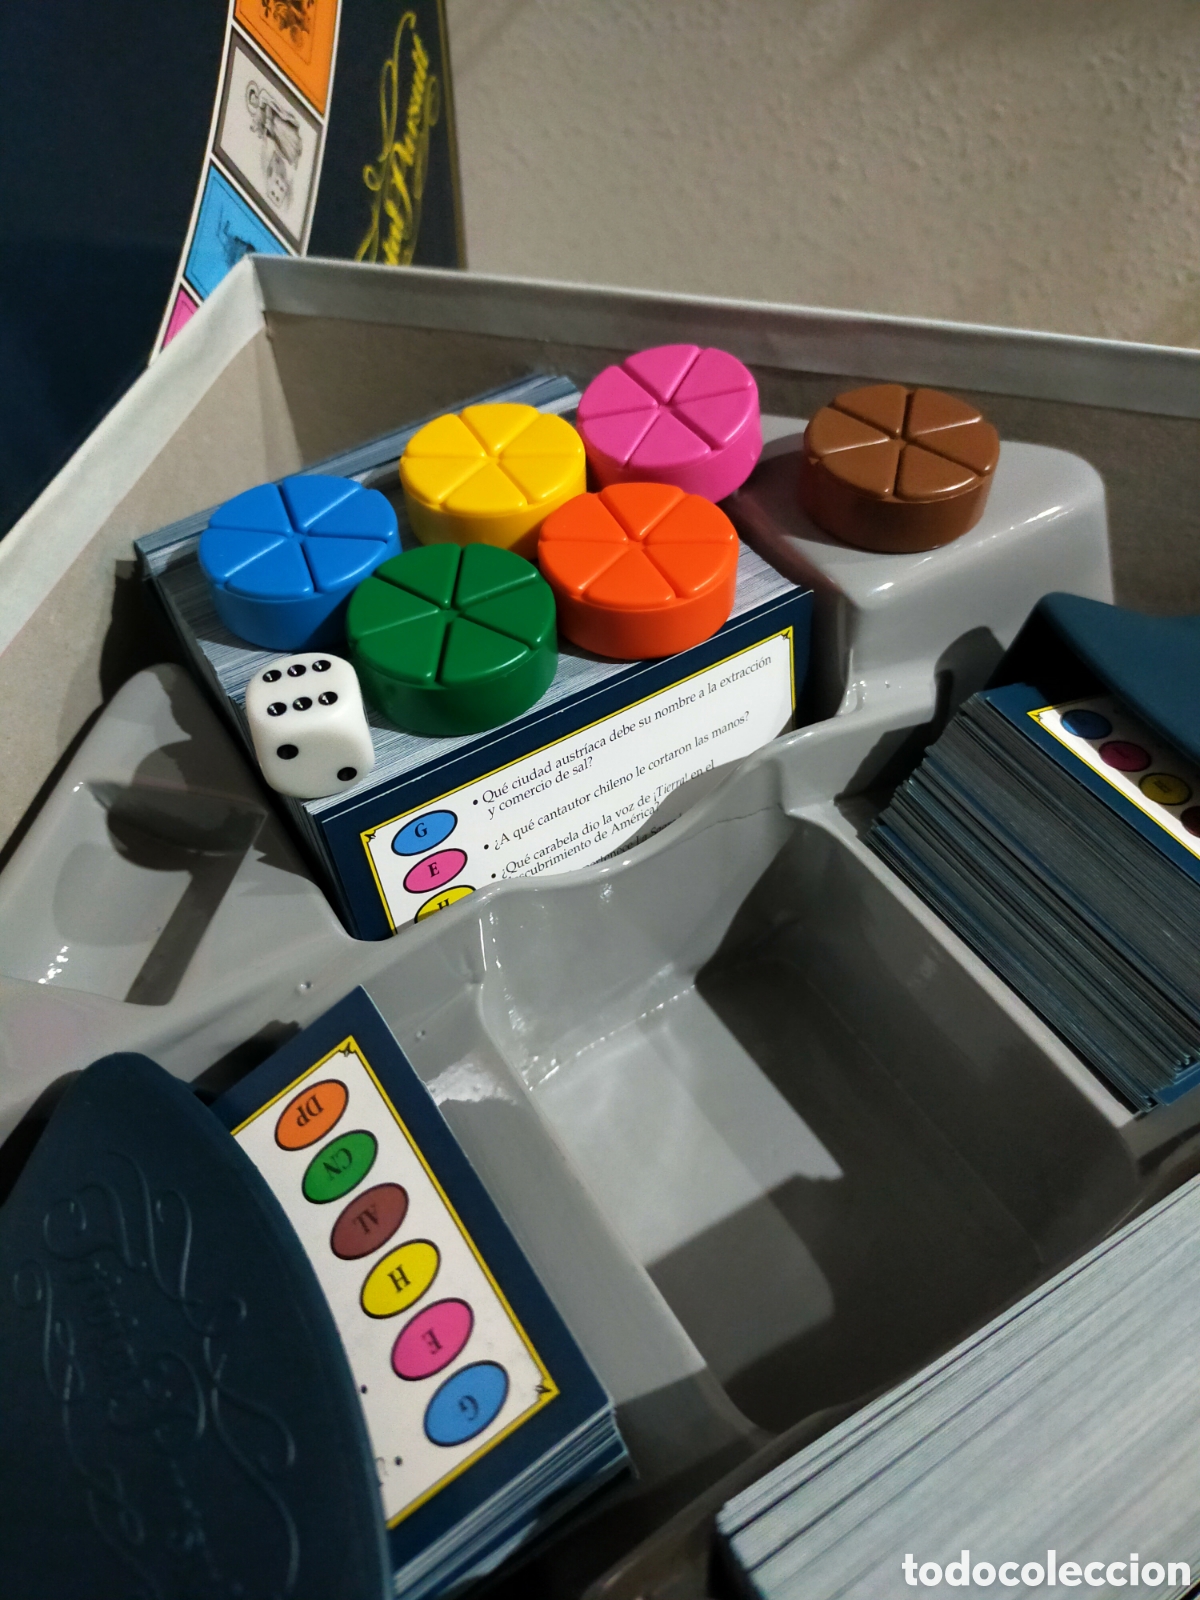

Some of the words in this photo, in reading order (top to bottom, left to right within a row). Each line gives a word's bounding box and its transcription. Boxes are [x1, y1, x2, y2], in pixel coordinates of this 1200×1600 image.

[481, 781, 509, 803] Qué
[512, 761, 552, 789] ciudad
[555, 738, 607, 769] austríaca
[609, 722, 636, 742] debe
[638, 716, 652, 728] su
[654, 693, 697, 720] nombre
[698, 689, 706, 698] a
[708, 682, 717, 694] la
[719, 655, 772, 688] extracción
[488, 806, 496, 820] y
[499, 779, 552, 811] comercio
[555, 770, 570, 783] de
[572, 756, 593, 775] sal?
[494, 833, 510, 850] ¿A
[513, 820, 535, 840] qué
[537, 793, 591, 826] cantautor
[593, 773, 633, 798] chileno
[636, 765, 646, 777] le
[648, 742, 692, 771] cortaron
[694, 733, 709, 747] las
[711, 710, 750, 739] manos?
[414, 822, 428, 838] G
[501, 853, 531, 879] ¿Qué
[533, 832, 579, 860] carabela
[581, 818, 600, 836] dio
[602, 814, 612, 825] la
[615, 803, 635, 818] voz
[637, 795, 651, 807] de
[690, 768, 703, 780] en
[705, 759, 715, 772] el
[509, 837, 592, 878] cubrimiento
[594, 831, 608, 844] de
[611, 801, 660, 835] América?
[427, 862, 440, 878] E
[296, 1094, 324, 1127] DP
[323, 1148, 353, 1181] CN
[352, 1204, 379, 1234] AL
[387, 1264, 411, 1293] H
[422, 1327, 443, 1355] E
[458, 1394, 479, 1422] G
